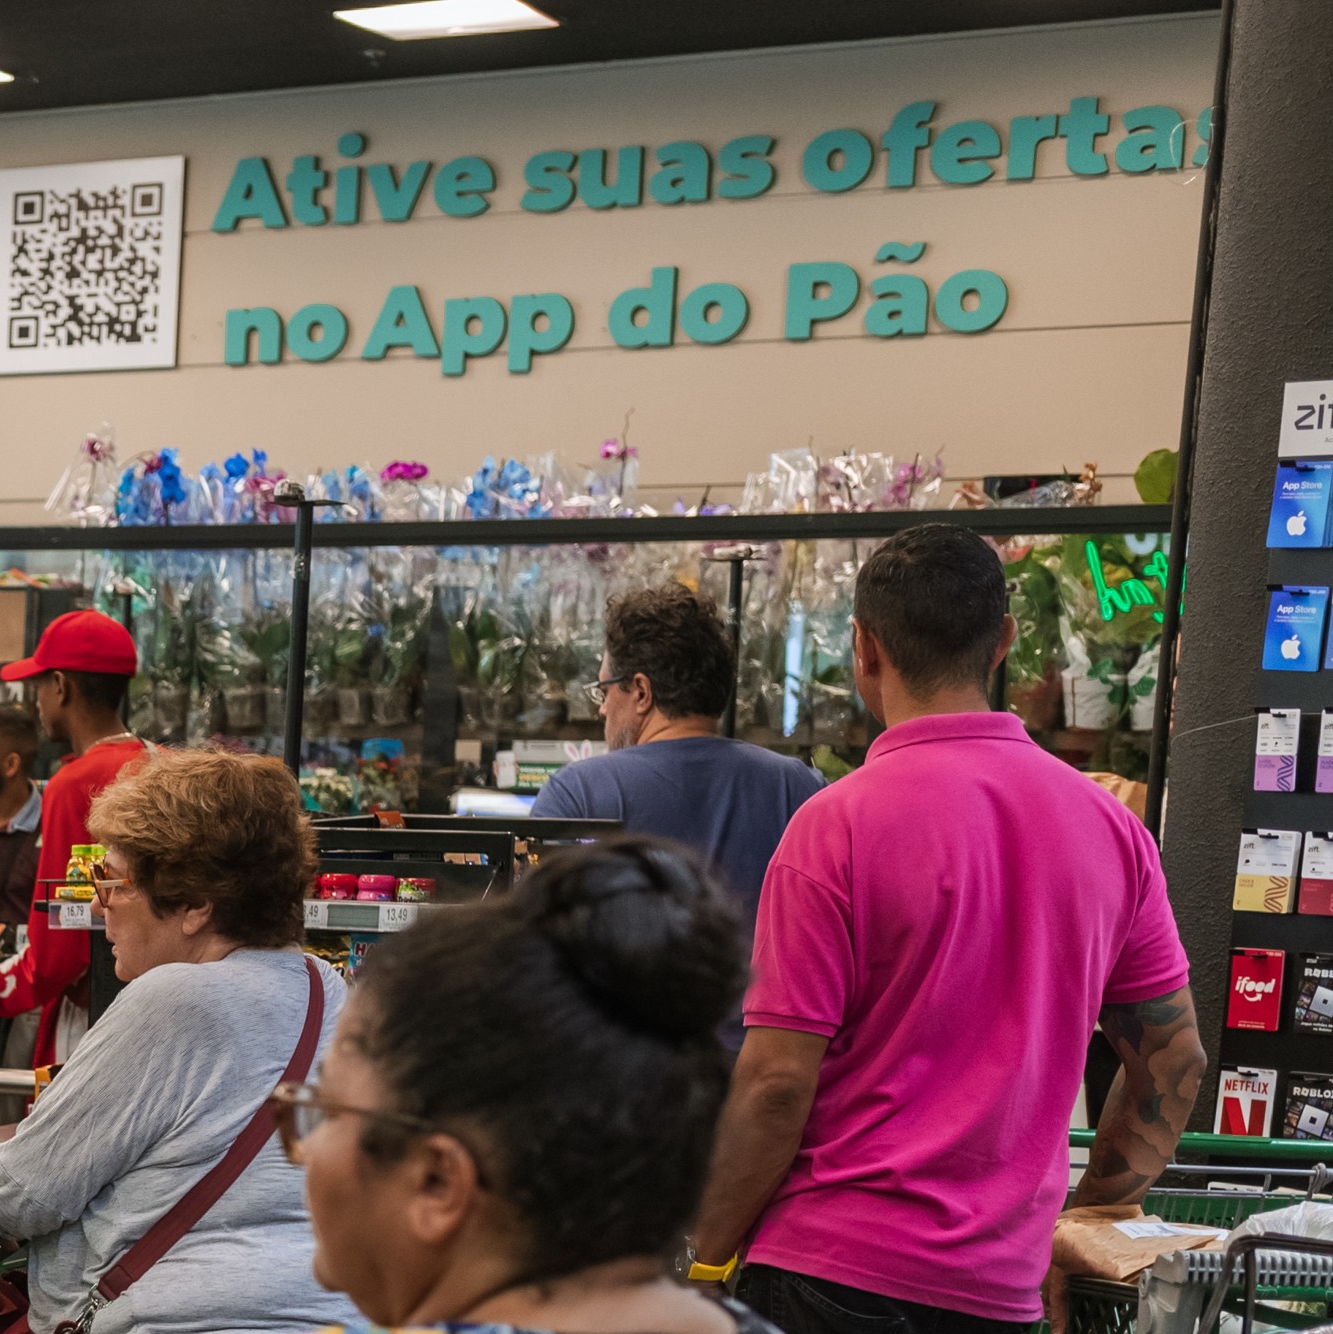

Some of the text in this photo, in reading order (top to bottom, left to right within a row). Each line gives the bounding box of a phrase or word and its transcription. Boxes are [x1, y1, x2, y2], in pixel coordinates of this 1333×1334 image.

[212, 132, 497, 233] Ative
[520, 135, 778, 214] suas
[224, 242, 1009, 377] no App do Pão
[1282, 481, 1323, 490] App Store
[1276, 605, 1317, 614] App Store
[386, 908, 408, 921] 13,49
[1224, 1079, 1269, 1095] NETFLIX
